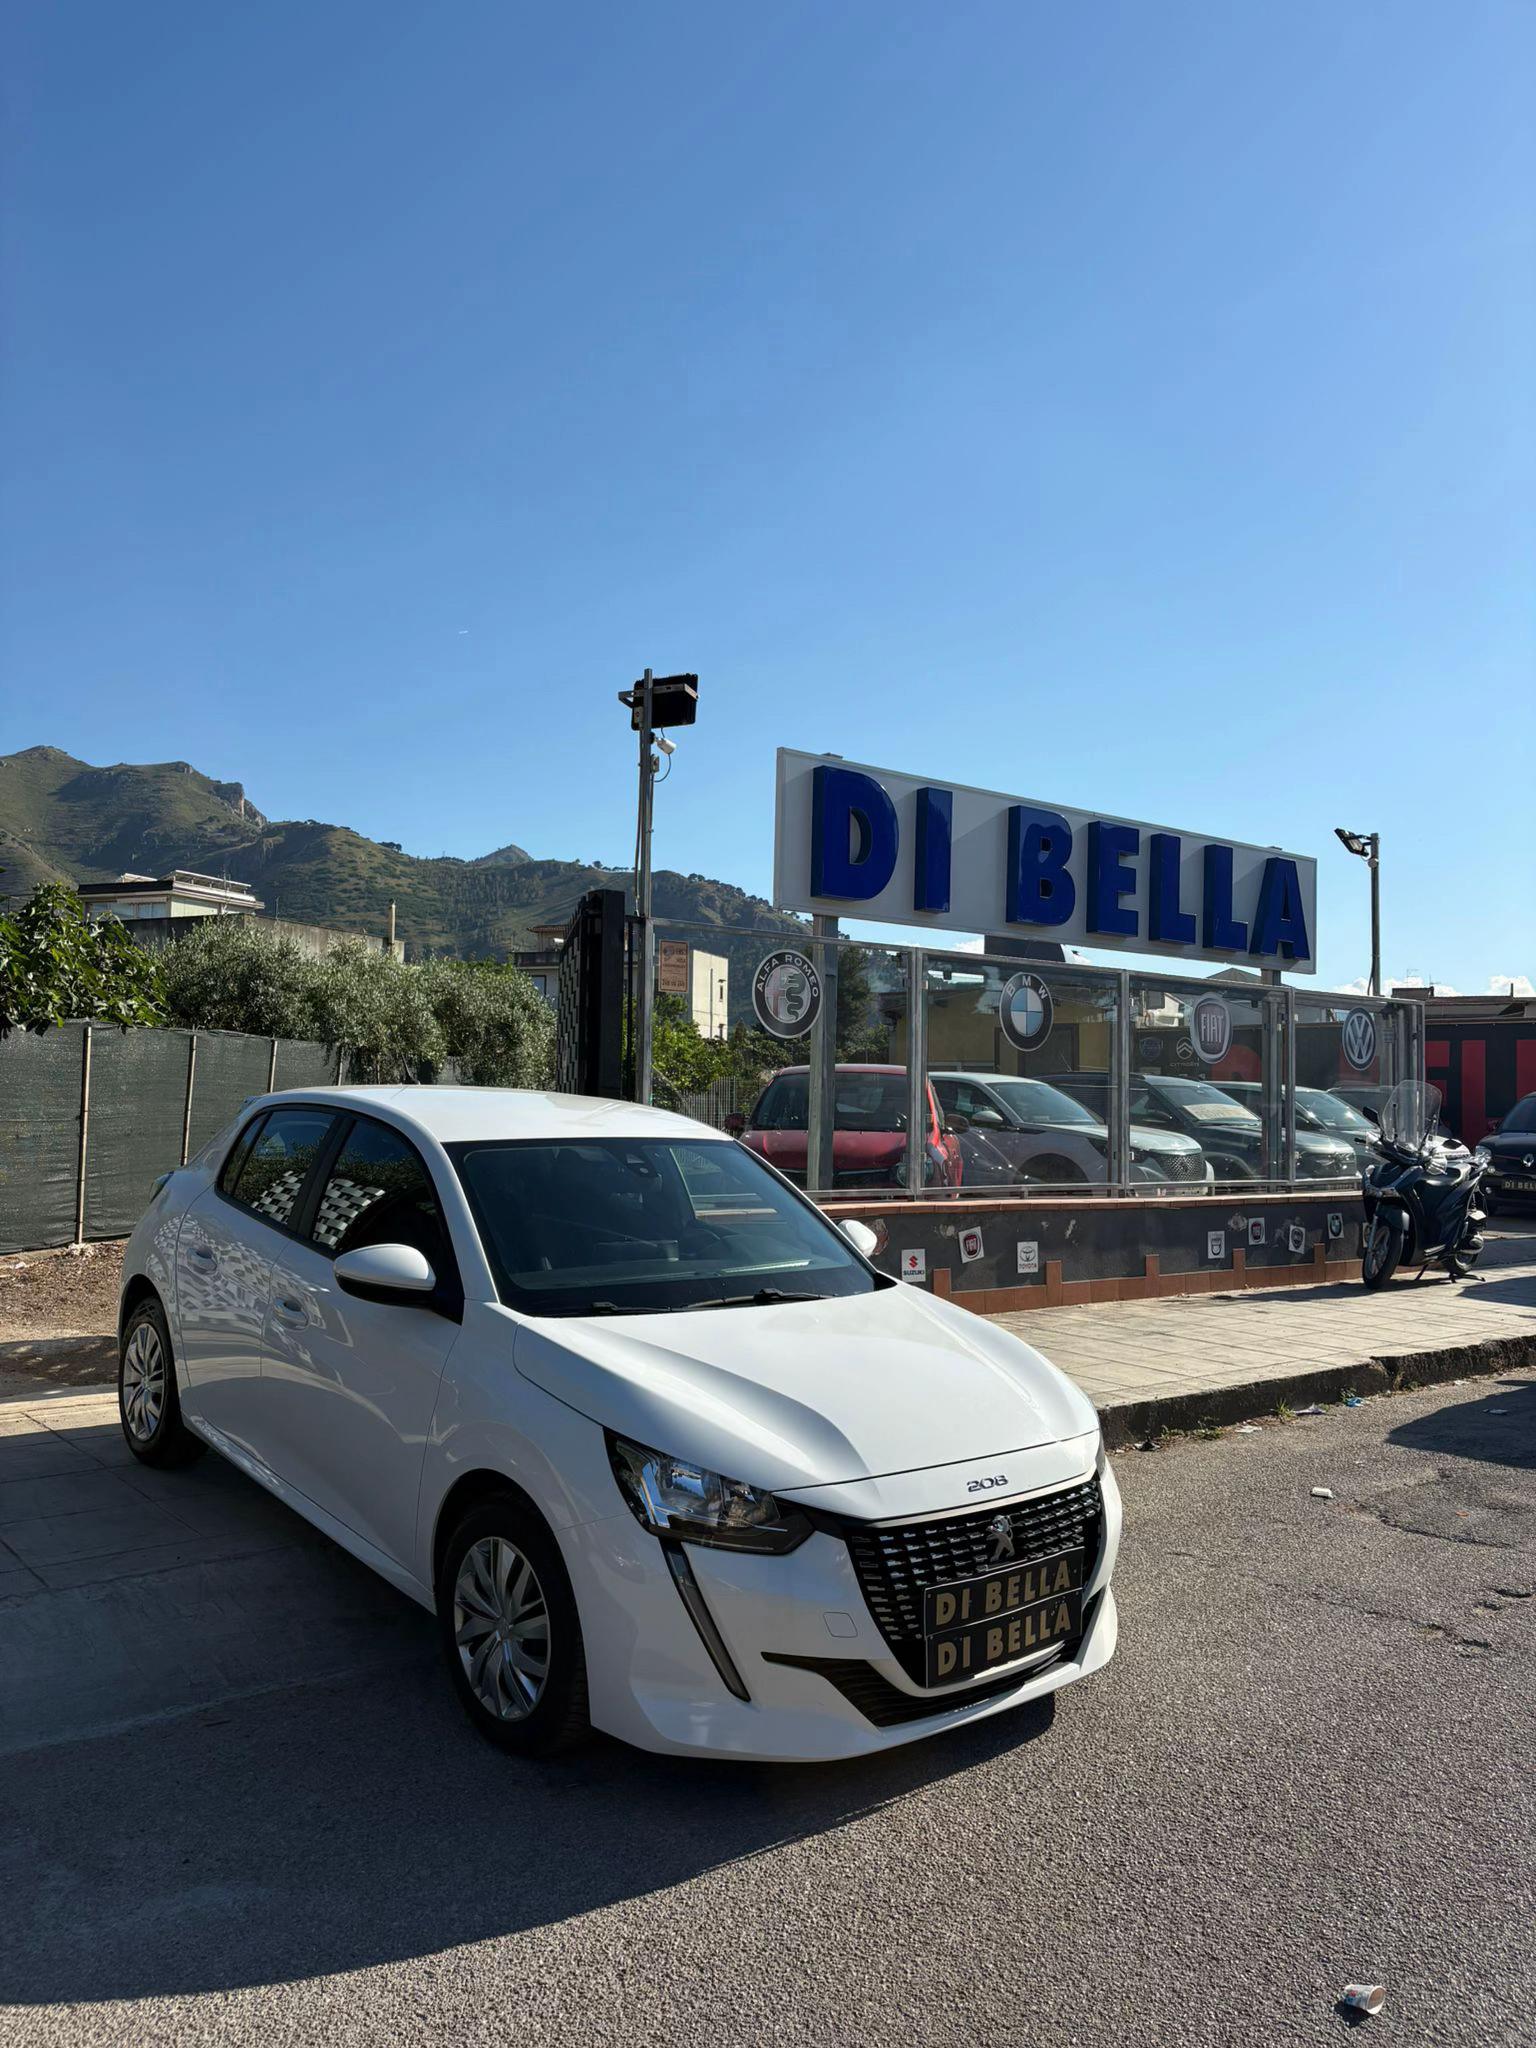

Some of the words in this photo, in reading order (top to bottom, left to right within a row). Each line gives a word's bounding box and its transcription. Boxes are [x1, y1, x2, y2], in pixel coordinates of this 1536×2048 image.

[810, 765, 953, 912] DI
[1005, 804, 1310, 960] BELLA
[756, 957, 779, 992] ALFA
[785, 953, 819, 998] ROMEO
[1005, 975, 1048, 1000] BMW
[1201, 1013, 1224, 1043] FIAT
[967, 1475, 1008, 1492] 208
[936, 1588, 971, 1626] DI
[985, 1560, 1070, 1613] BELLA
[938, 1636, 971, 1676] DI
[987, 1603, 1071, 1661] BELLA
